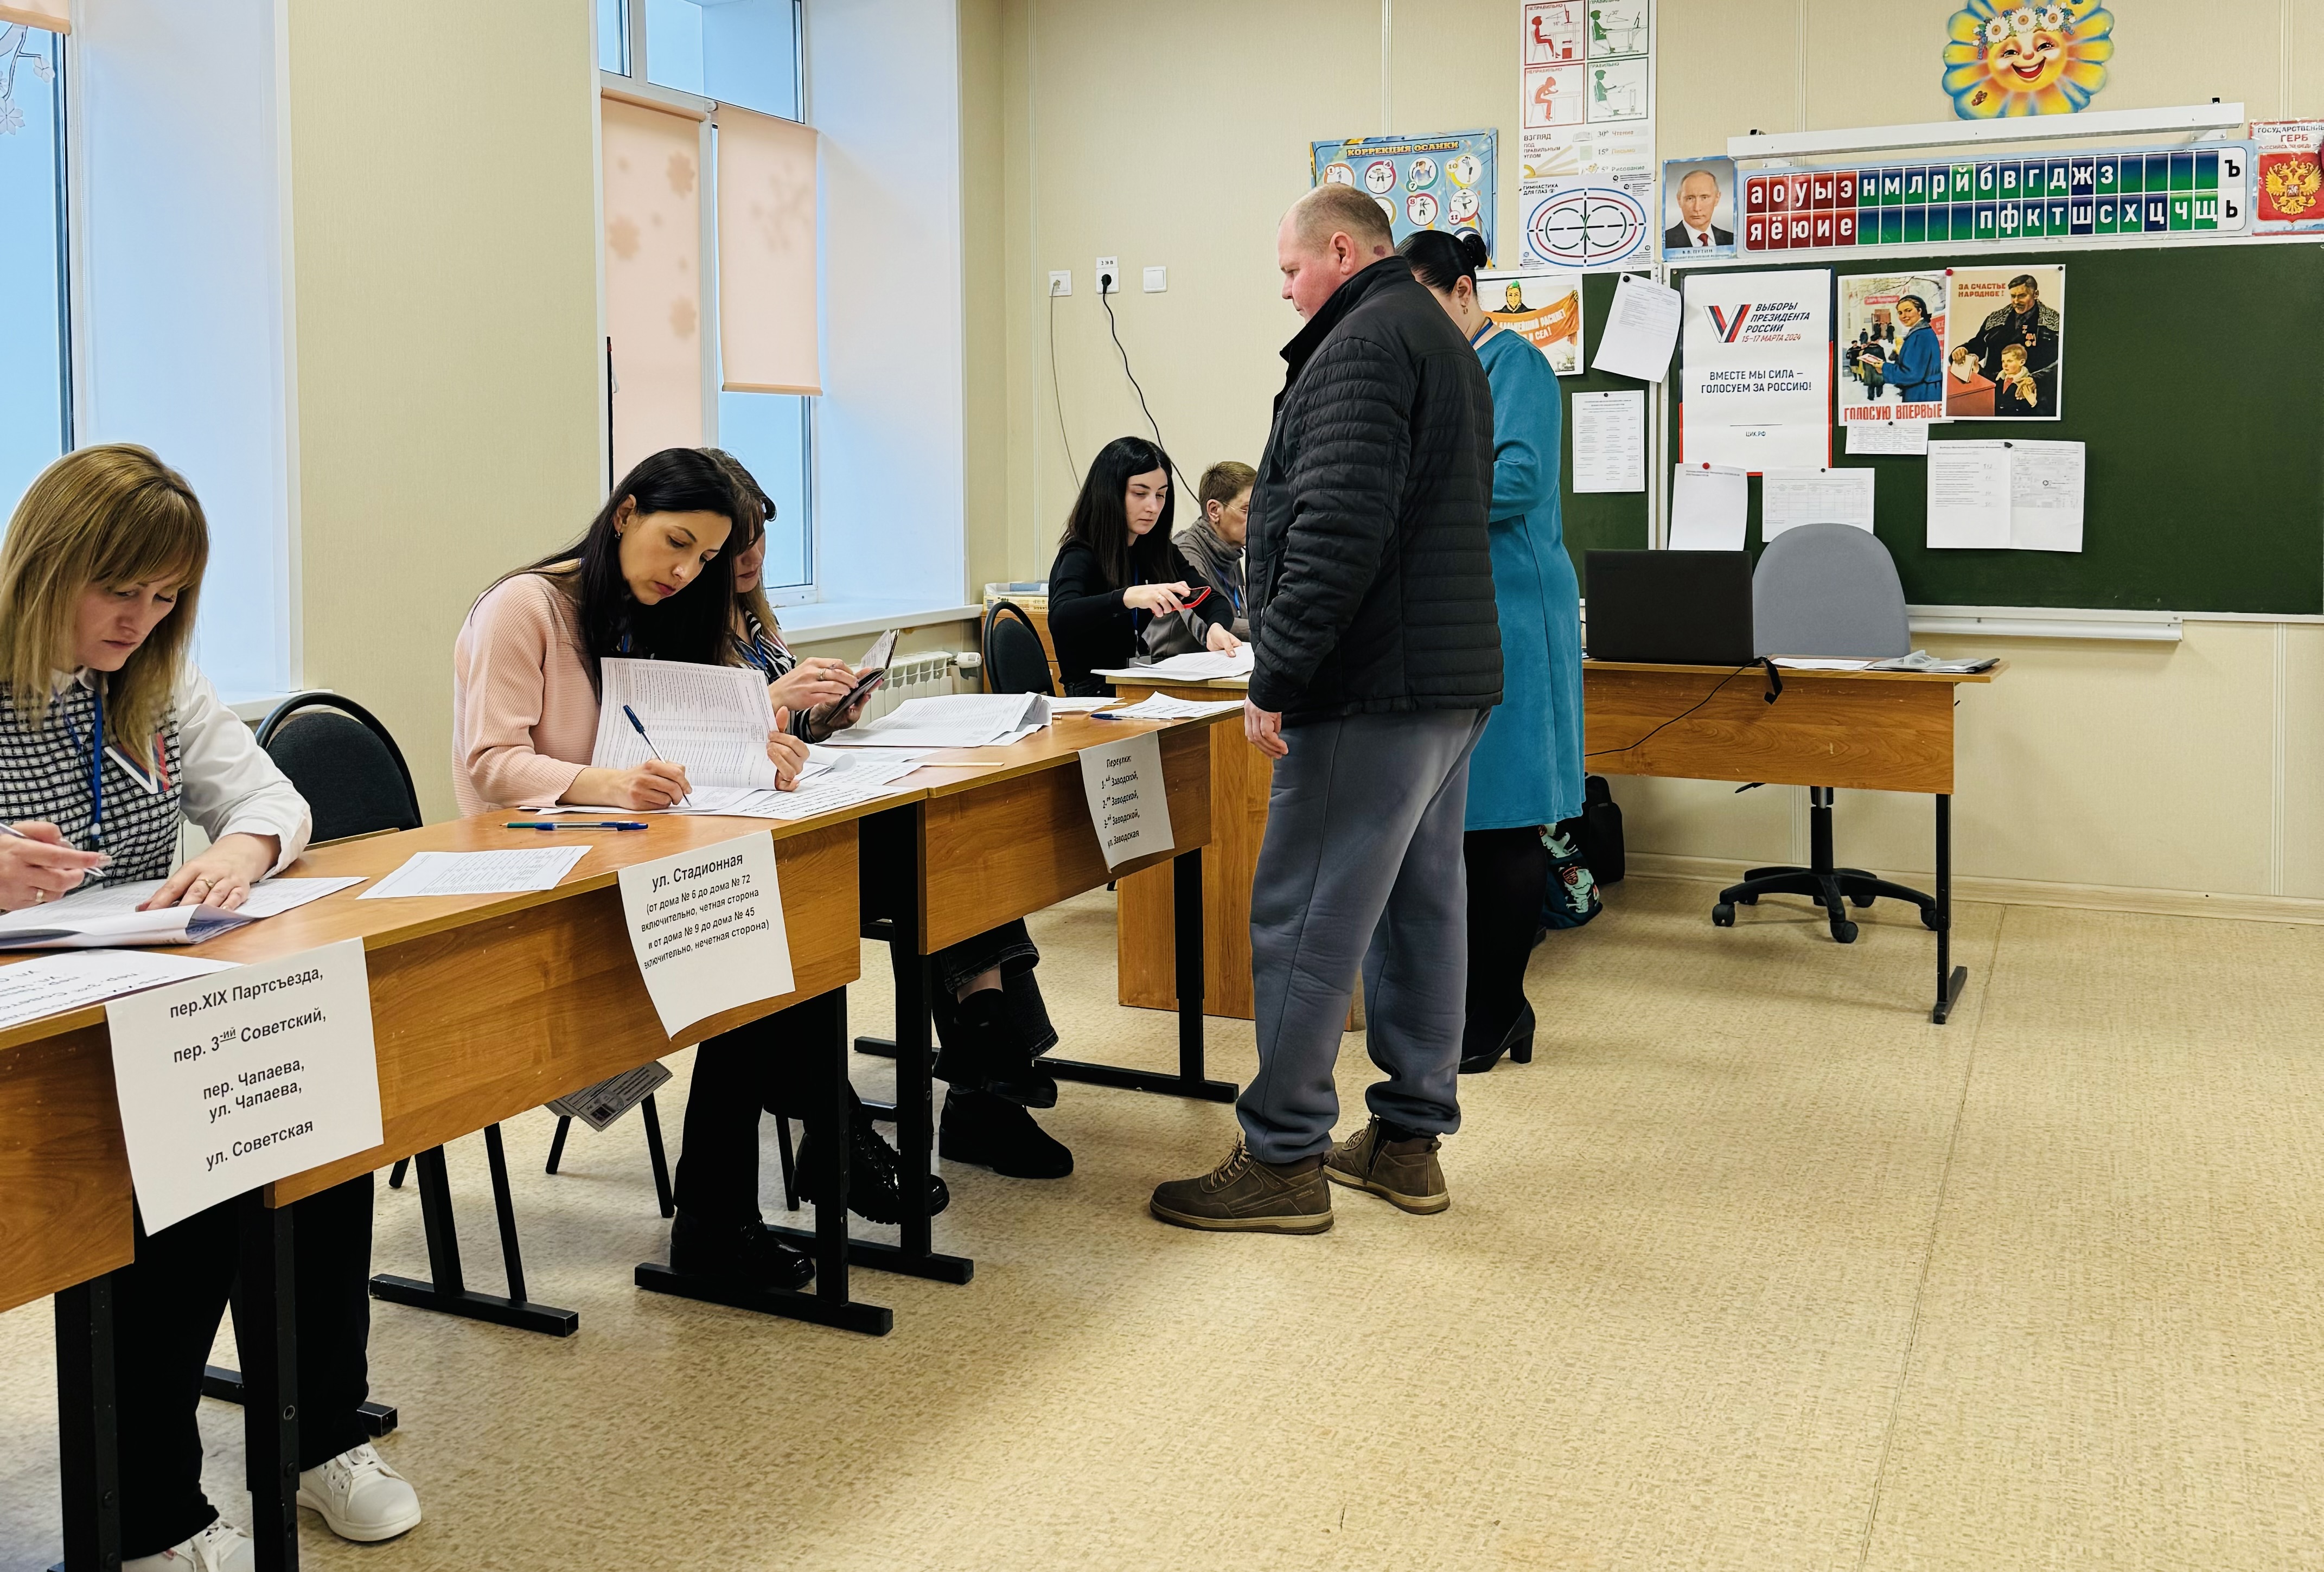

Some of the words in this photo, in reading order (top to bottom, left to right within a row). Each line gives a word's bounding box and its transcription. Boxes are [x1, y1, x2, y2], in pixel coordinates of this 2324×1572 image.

[1346, 145, 1412, 156] КОРРЕКЦИЯ
[1414, 140, 1459, 152] ОСАНКИ
[2281, 134, 2308, 142] ГЕРБ
[1750, 312, 1810, 323] ПРЕЗИДЕНТА
[1755, 302, 1798, 311] ВЫБОРЫ
[1745, 324, 1784, 333] РОССИИ
[1701, 384, 1750, 393] ГОЛОСУЕМ
[1753, 383, 1765, 392] ЗА
[1767, 382, 1811, 392] РОССИЮ!
[1710, 371, 1746, 380] ВМЕСТЕ
[1749, 370, 1766, 379] МЫ
[1768, 369, 1794, 379] СИЛА
[1844, 406, 1891, 421] ГОЛОСУЮ
[1896, 404, 1942, 419] ВПЕРВЫЕ
[652, 876, 670, 893] ул.
[673, 854, 743, 883] Стадионная
[641, 908, 698, 932] включительно,
[699, 899, 725, 912] четная
[727, 890, 759, 905] сторона
[646, 903, 657, 916] (от
[659, 897, 679, 911] дома
[681, 892, 689, 903] №
[691, 890, 696, 899] 6
[698, 887, 708, 899] до
[710, 882, 730, 896] дома
[731, 877, 740, 888] №
[742, 874, 751, 885] 72
[654, 938, 662, 948] от
[663, 931, 682, 945] дома
[685, 926, 693, 937] №
[694, 924, 699, 933] 9
[701, 922, 711, 933] до
[713, 916, 732, 930] дома
[735, 911, 743, 922] №
[745, 907, 755, 918] 45
[695, 931, 730, 950] нечетная
[731, 919, 769, 937] сторона)
[170, 989, 228, 1018] пер.XIX
[232, 967, 323, 1002] Партсъезда,
[174, 1044, 206, 1063] пер.
[240, 1006, 326, 1043] Советский,
[203, 1082, 233, 1100] пер.
[238, 1059, 305, 1088] Чапаева,
[209, 1103, 231, 1123] ул.
[235, 1081, 302, 1110] Чапаева,
[206, 1152, 228, 1172] ул.
[232, 1120, 313, 1157] Советская
